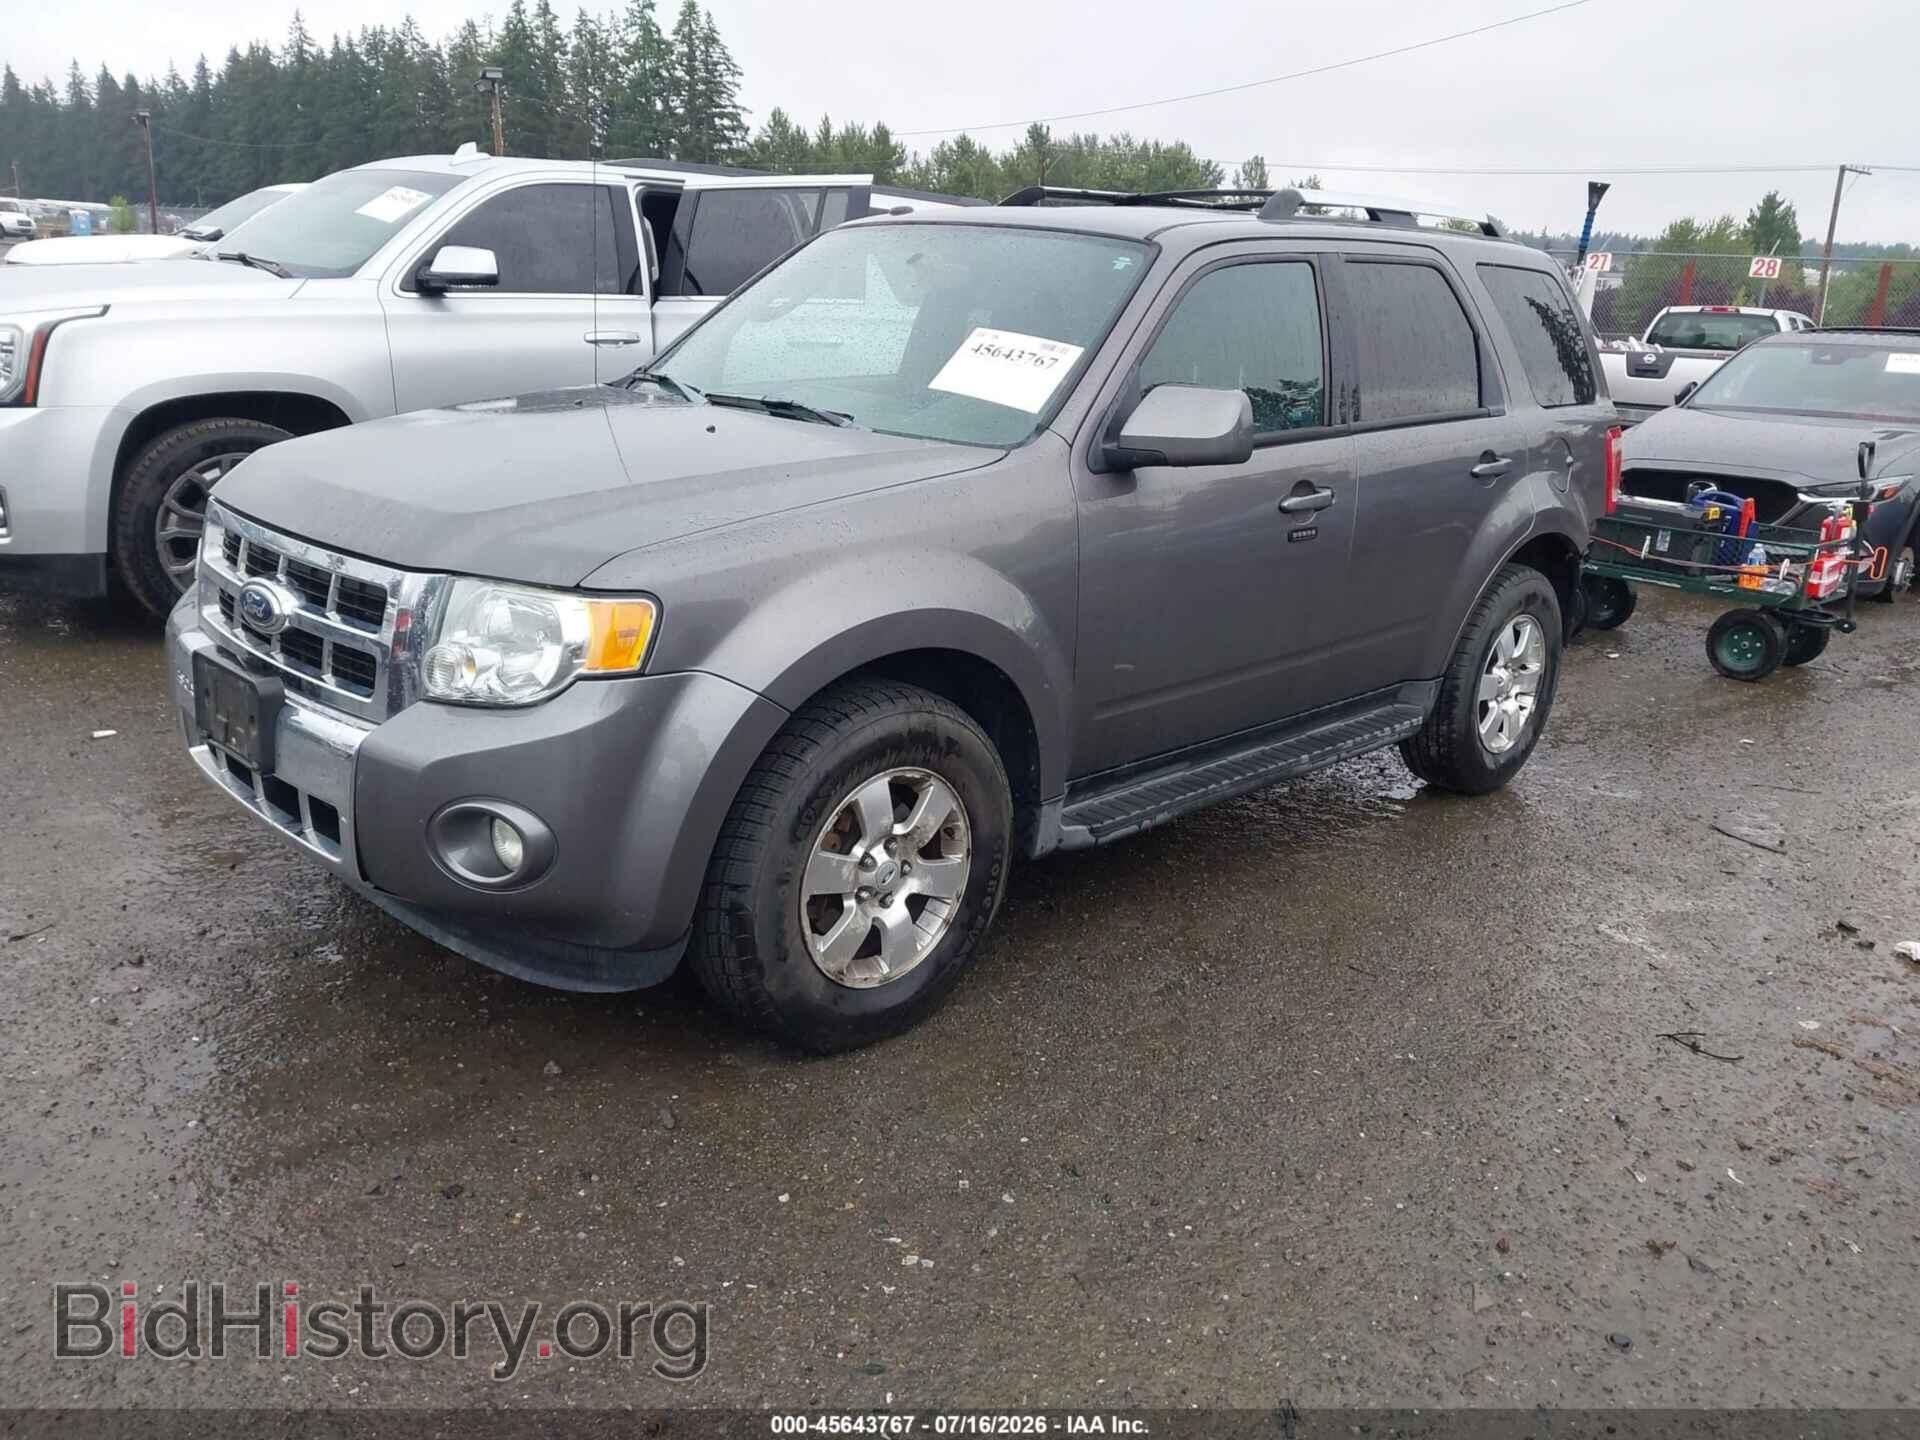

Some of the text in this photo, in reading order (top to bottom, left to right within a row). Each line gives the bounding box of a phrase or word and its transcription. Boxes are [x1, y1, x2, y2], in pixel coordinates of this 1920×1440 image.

[1589, 254, 1609, 271] 27
[1753, 259, 1778, 277] 28
[971, 343, 1059, 369] 45643767
